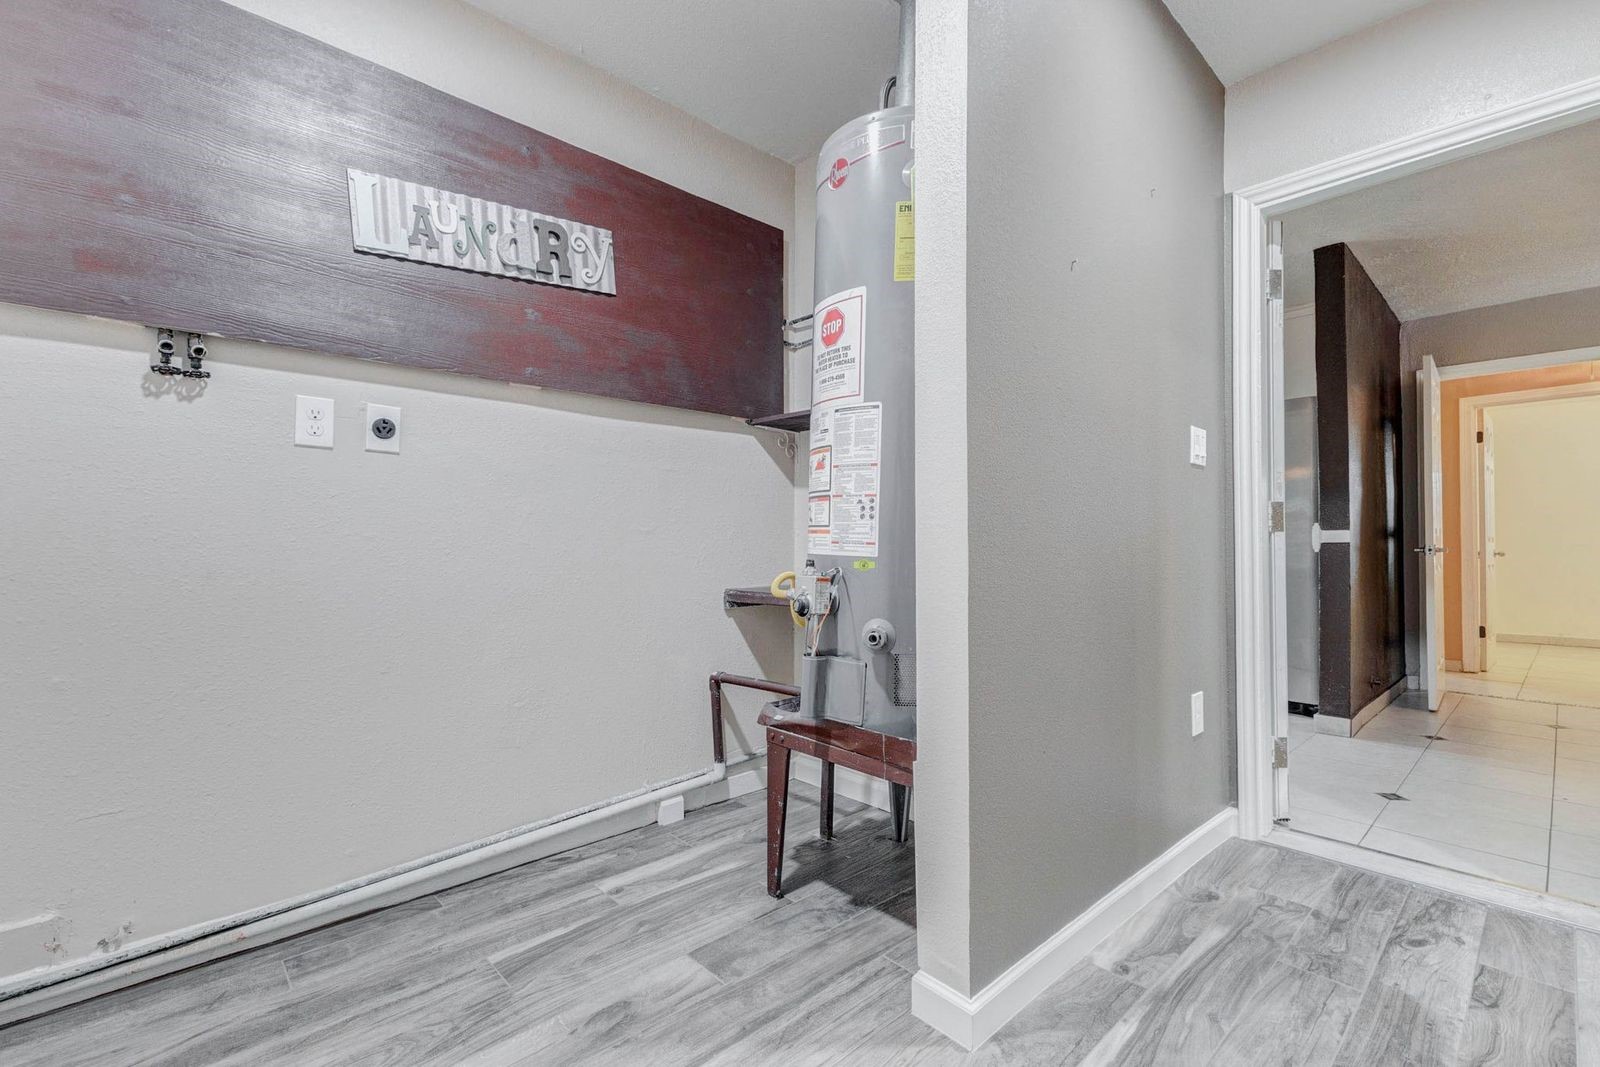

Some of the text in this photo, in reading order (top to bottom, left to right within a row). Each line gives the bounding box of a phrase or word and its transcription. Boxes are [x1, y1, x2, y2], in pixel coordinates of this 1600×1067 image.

[822, 319, 842, 337] STOP
[827, 347, 841, 356] RETURN
[827, 353, 841, 363] HEATER
[833, 357, 855, 367] PURCHASE
